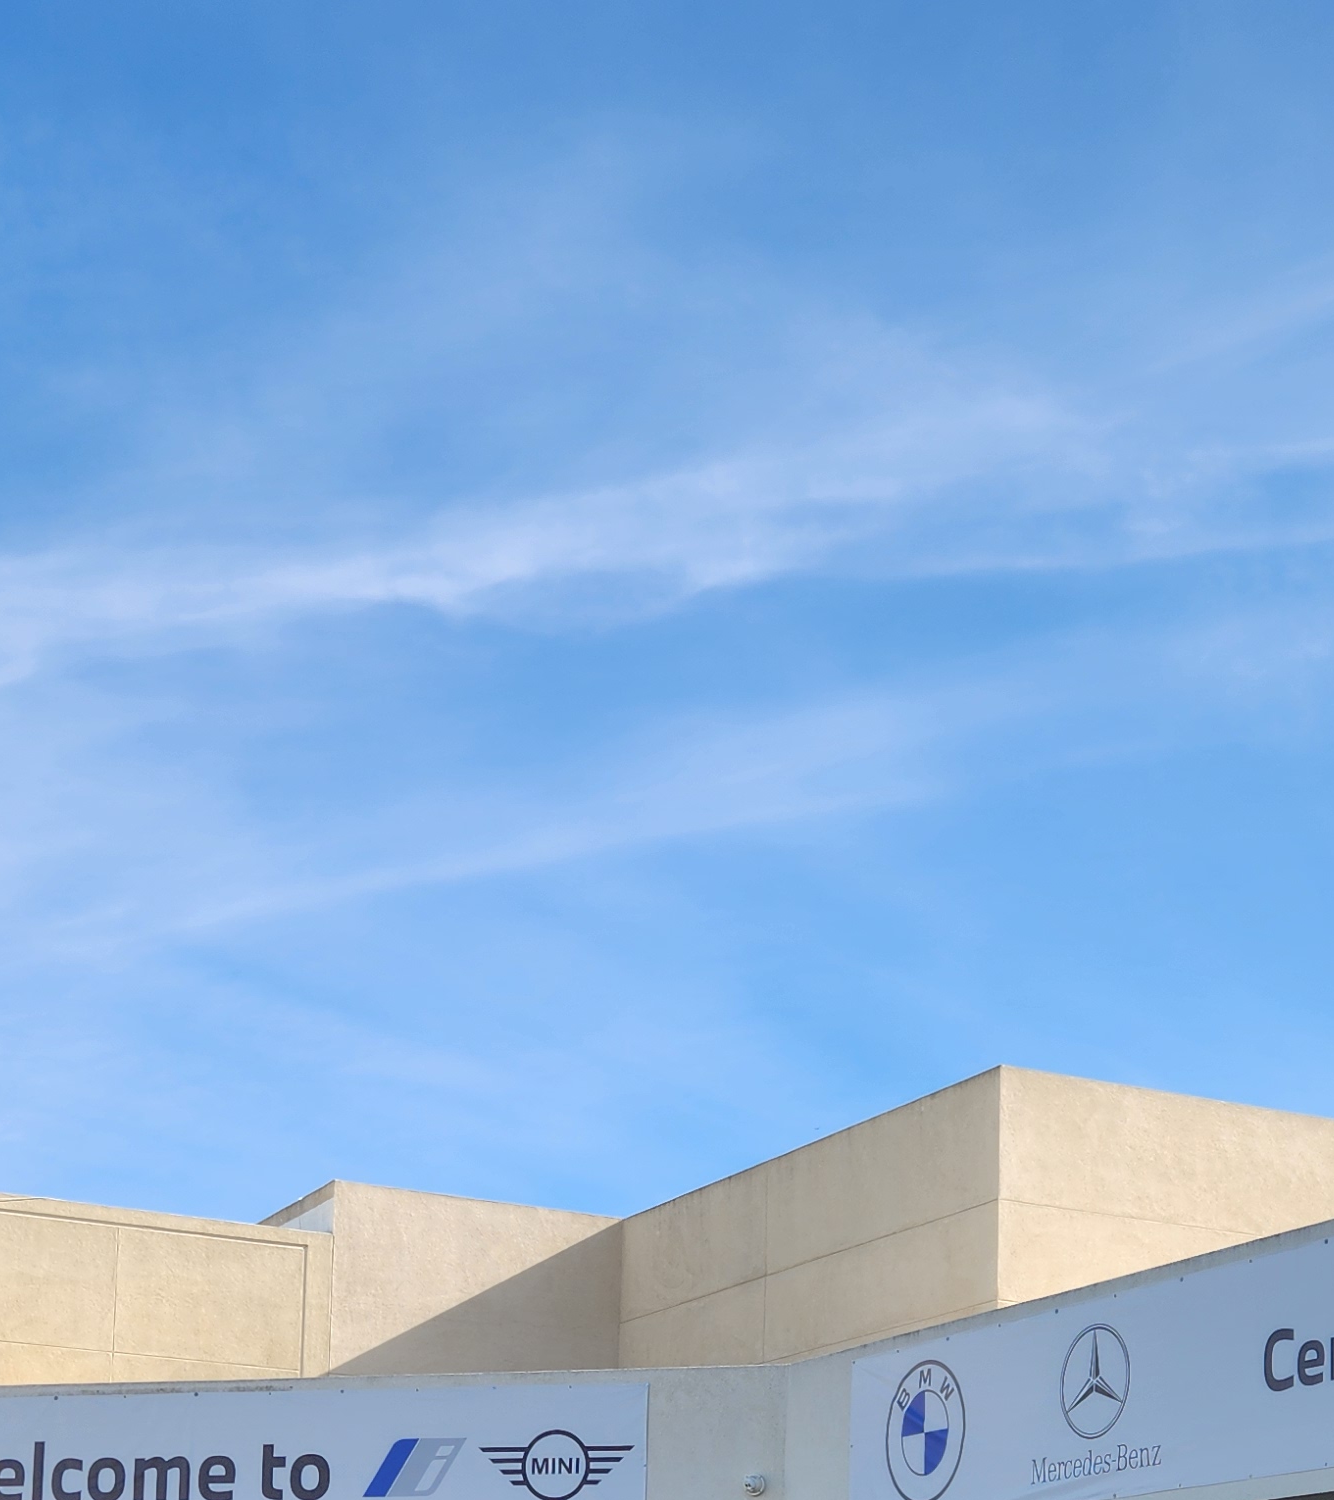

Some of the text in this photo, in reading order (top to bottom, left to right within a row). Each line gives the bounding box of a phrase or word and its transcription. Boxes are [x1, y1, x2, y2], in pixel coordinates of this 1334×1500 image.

[896, 1368, 955, 1411] BMW
[530, 1455, 582, 1476] MINI
[1030, 1442, 1162, 1486] Mercedes-Benz
